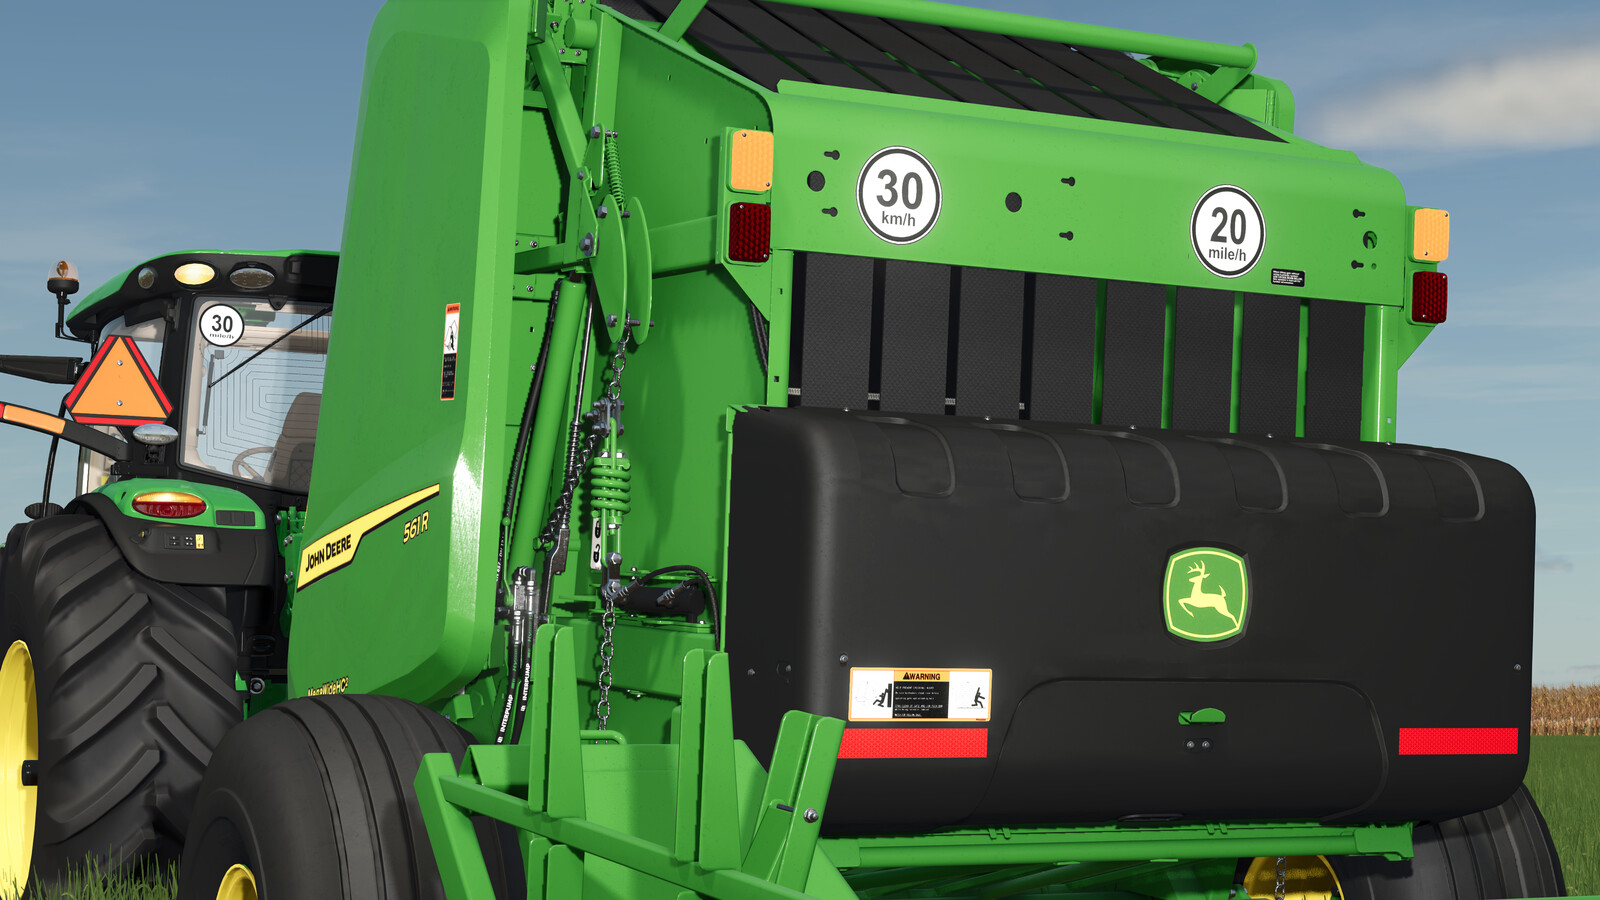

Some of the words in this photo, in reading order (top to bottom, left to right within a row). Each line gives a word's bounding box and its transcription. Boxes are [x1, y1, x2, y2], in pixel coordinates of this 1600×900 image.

[876, 169, 923, 210] 30
[881, 211, 916, 227] km/h
[1210, 207, 1247, 245] 20
[1208, 246, 1247, 262] mile/h
[211, 314, 233, 333] 30
[305, 548, 325, 572] JOHN
[325, 534, 352, 561] DEERE
[522, 663, 531, 701] INTERPUMP
[909, 672, 941, 681] WARNING
[500, 694, 514, 733] INTERPUMP
